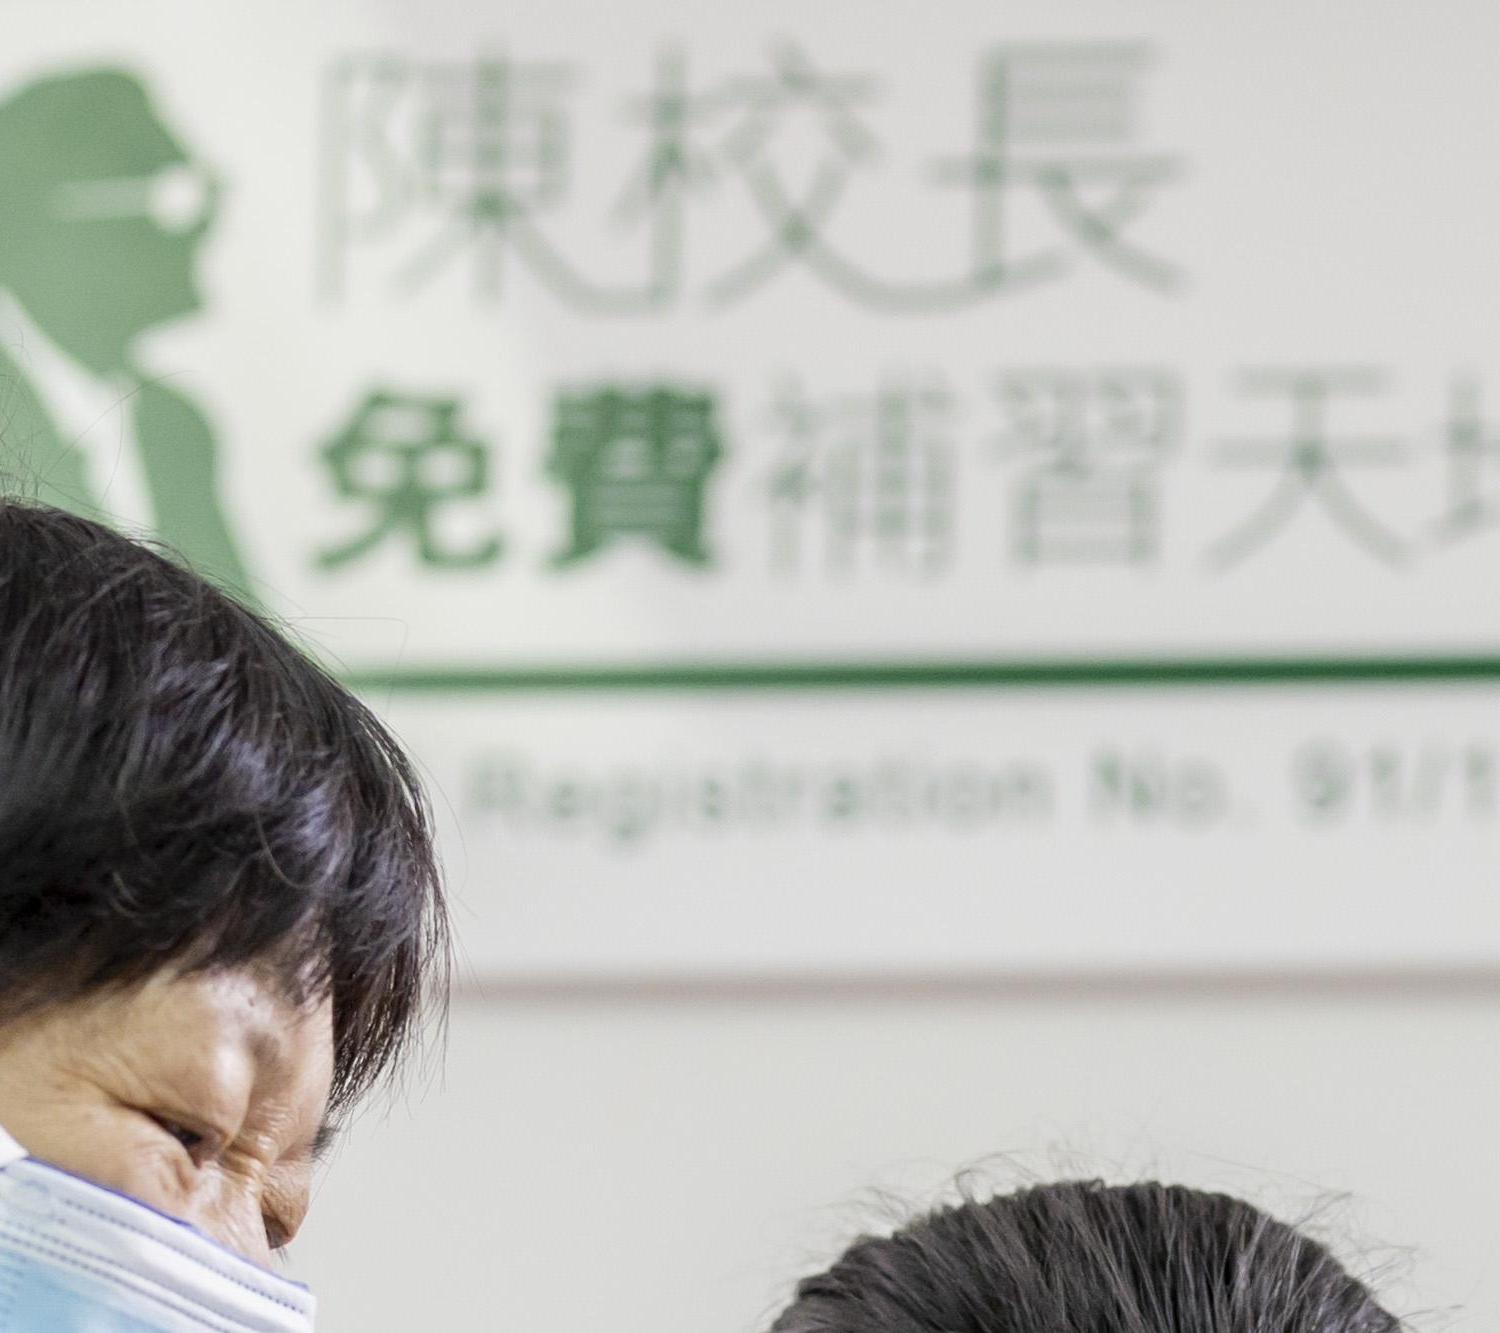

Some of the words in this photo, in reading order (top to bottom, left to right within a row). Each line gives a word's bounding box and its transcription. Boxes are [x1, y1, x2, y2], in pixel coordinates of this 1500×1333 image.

[318, 42, 1190, 312] 陳校長
[463, 748, 1053, 852] Registration
[1092, 746, 1255, 832] No.
